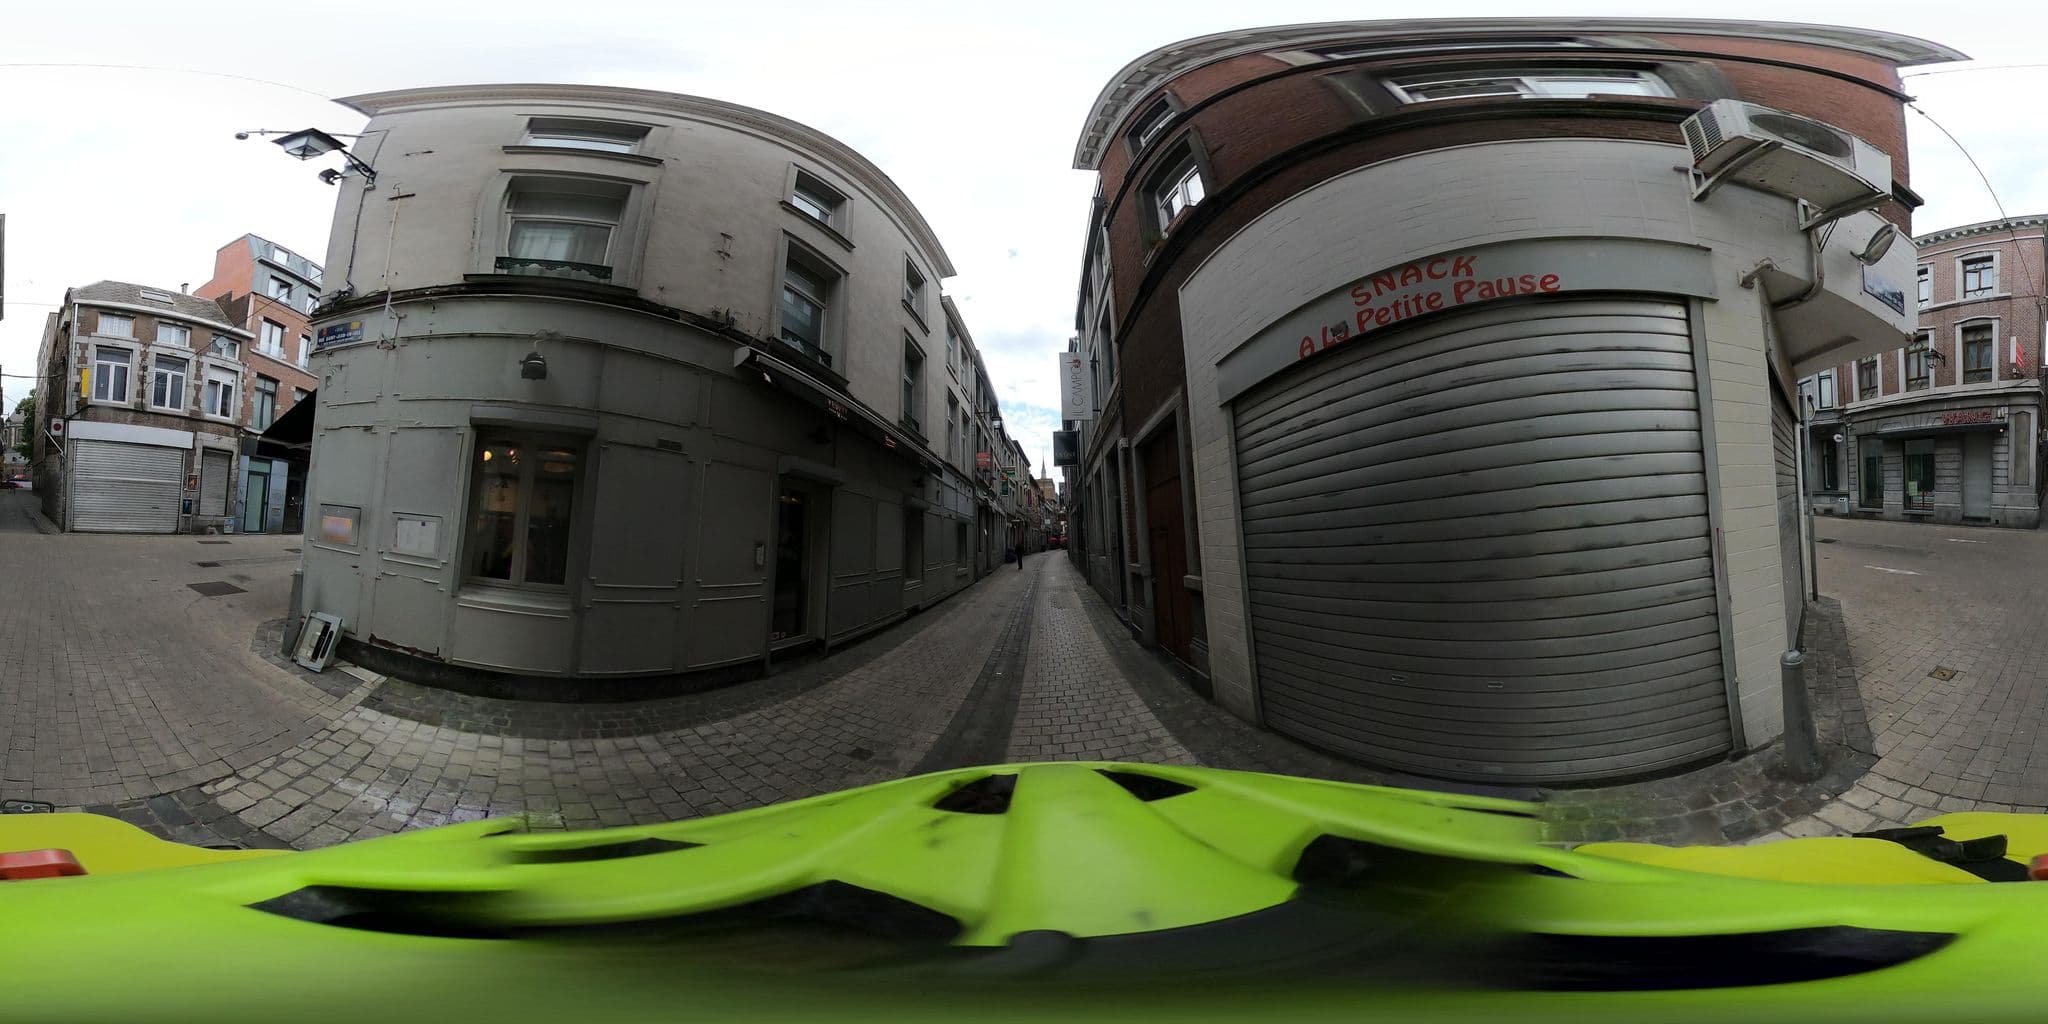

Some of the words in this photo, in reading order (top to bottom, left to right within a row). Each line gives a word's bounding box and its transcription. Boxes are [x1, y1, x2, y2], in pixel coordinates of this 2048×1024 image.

[1351, 254, 1478, 306] SNACK
[1299, 335, 1315, 361] A
[1356, 291, 1443, 333] Petite
[1453, 273, 1560, 304] Pause
